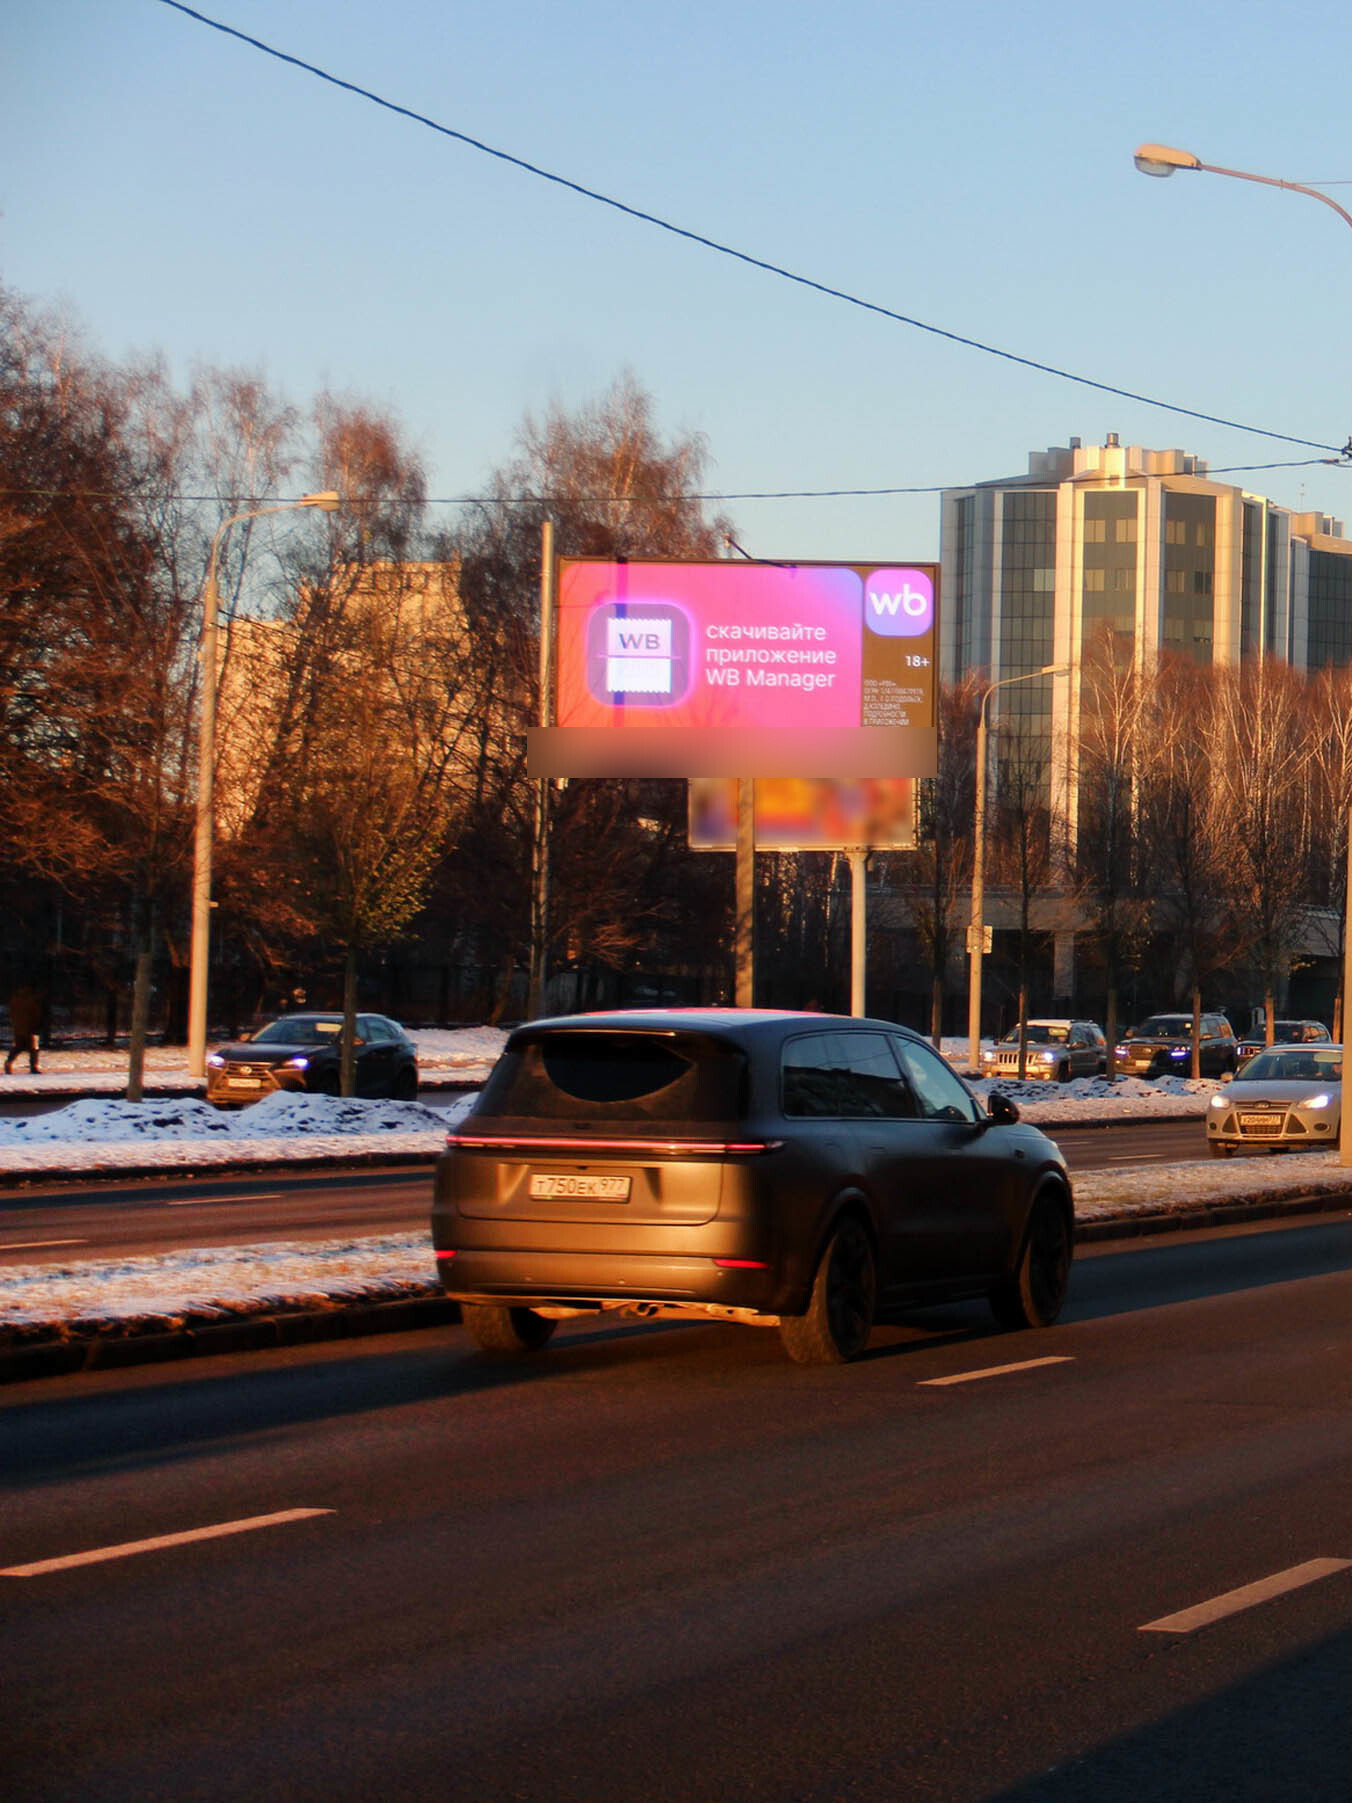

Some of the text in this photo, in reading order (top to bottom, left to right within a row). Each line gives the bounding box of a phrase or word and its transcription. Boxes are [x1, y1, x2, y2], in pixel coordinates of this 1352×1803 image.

[869, 583, 928, 616] wb
[705, 622, 827, 641] скачивайте
[618, 633, 661, 650] WB
[705, 648, 837, 666] приложение
[905, 655, 931, 667] 18+
[705, 668, 836, 692] WB Manager
[600, 1178, 625, 1192] 977
